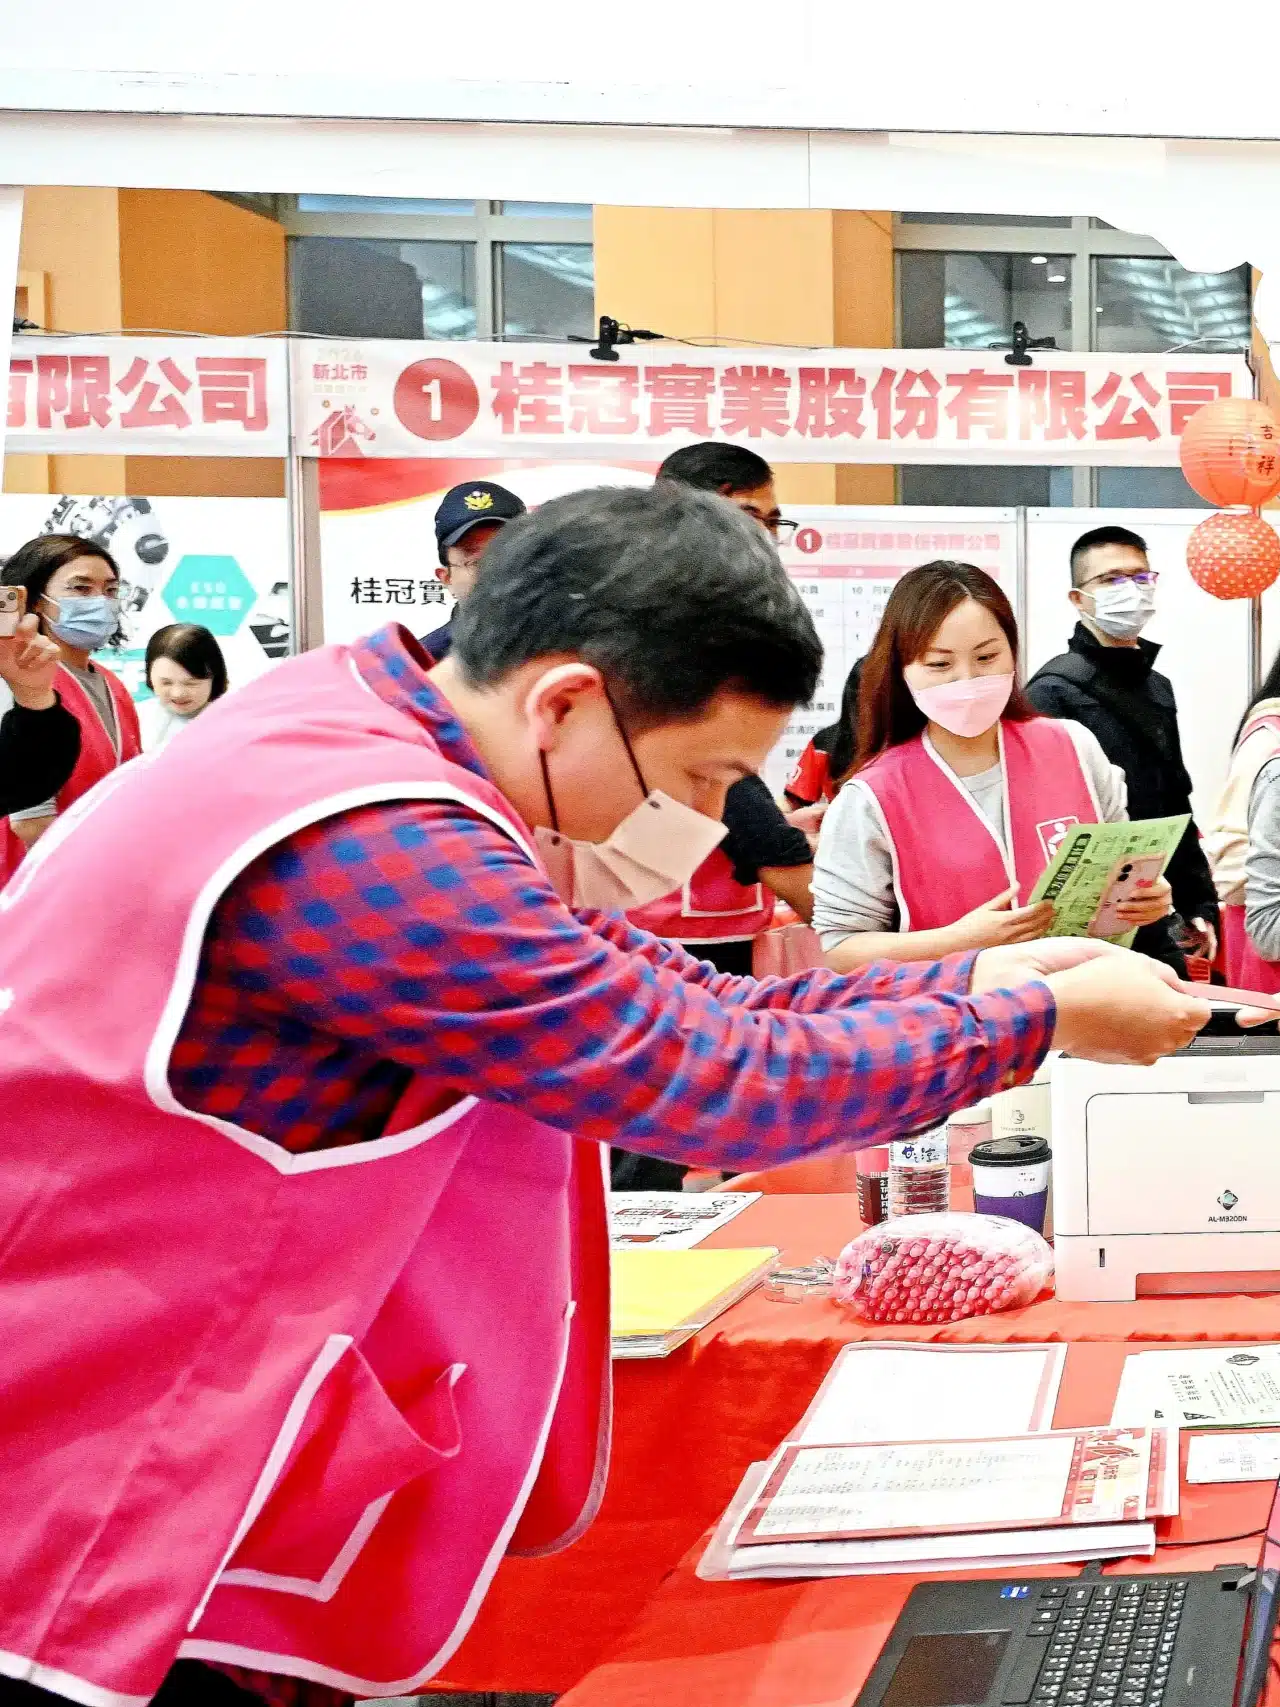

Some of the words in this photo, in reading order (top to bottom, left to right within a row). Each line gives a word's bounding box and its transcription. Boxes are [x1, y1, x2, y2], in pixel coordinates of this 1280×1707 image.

[312, 363, 368, 381] 新北市
[490, 361, 1232, 441] 桂冠實業股份有限公司
[350, 577, 447, 605] 桂冠實
